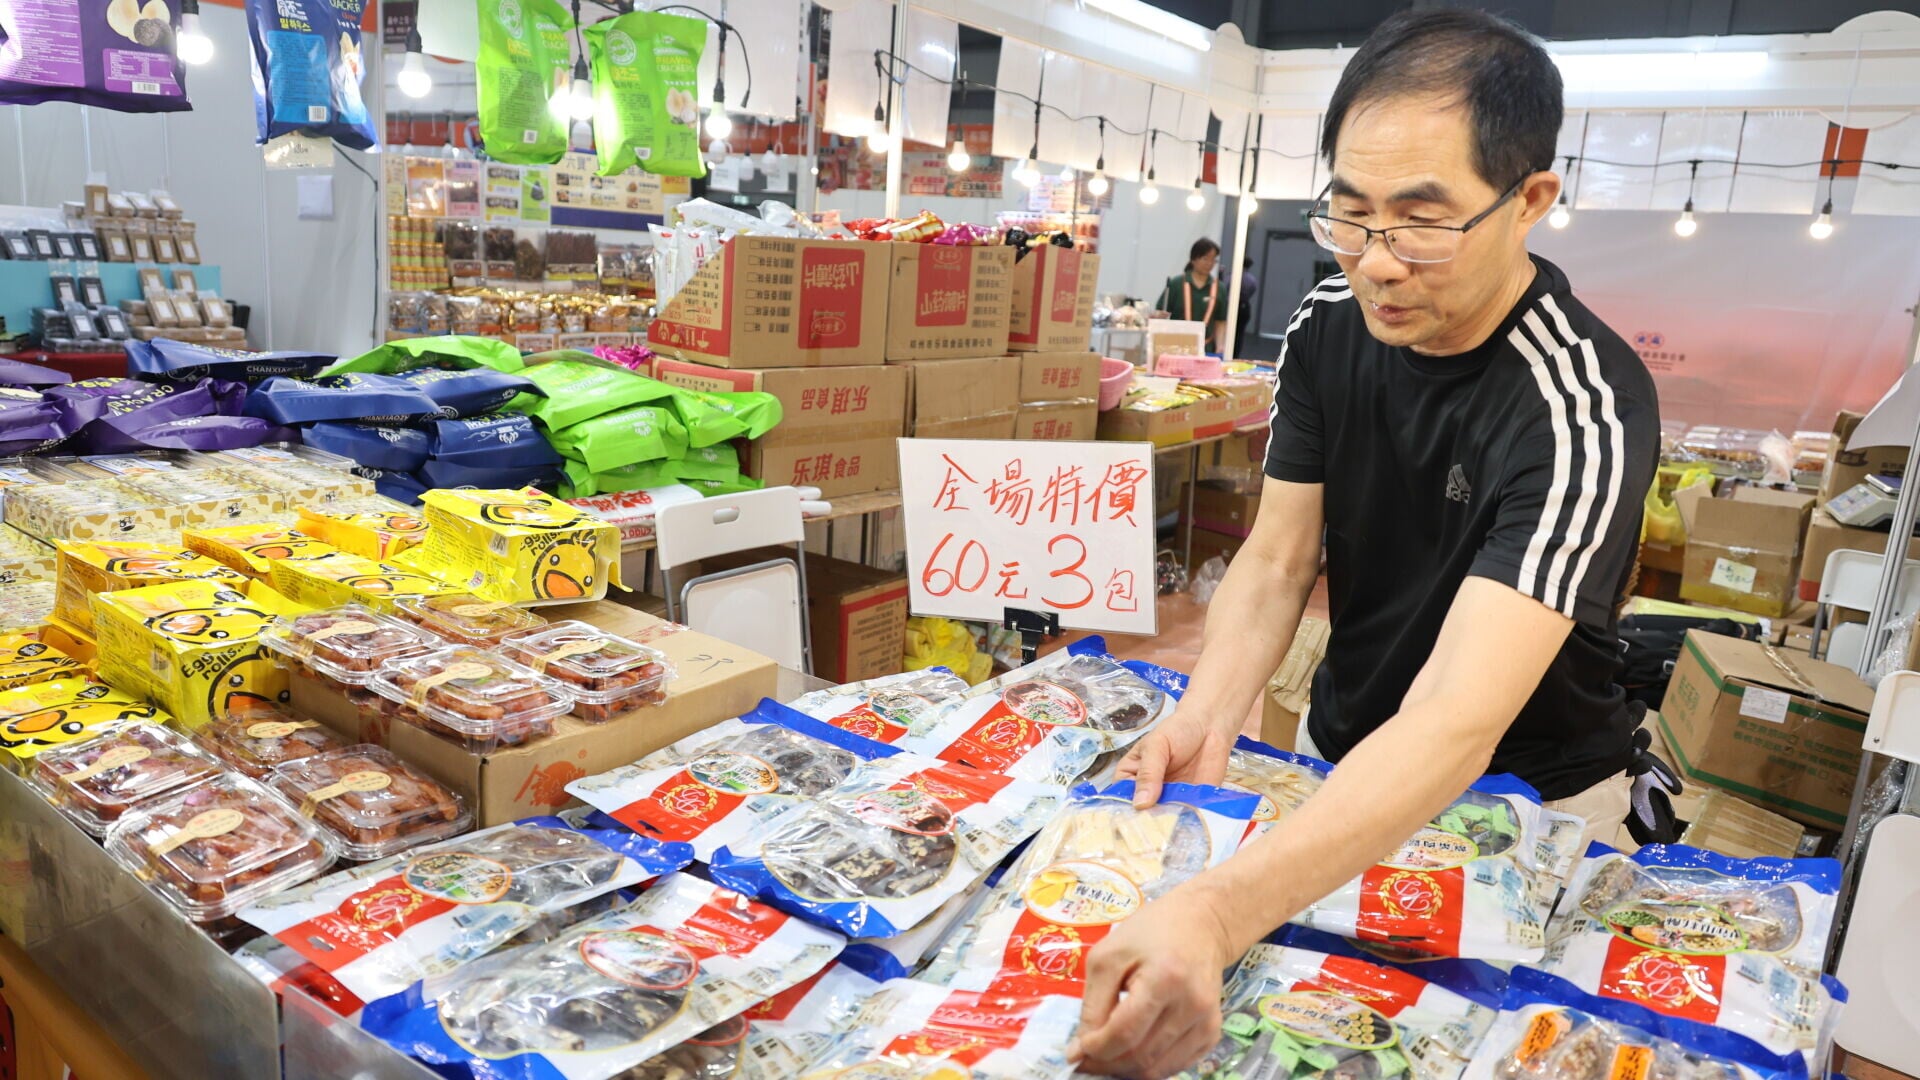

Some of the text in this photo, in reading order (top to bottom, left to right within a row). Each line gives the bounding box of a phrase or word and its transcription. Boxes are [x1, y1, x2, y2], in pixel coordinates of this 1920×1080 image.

[803, 261, 860, 291] 山药薄片
[919, 288, 968, 317] 山药薄片
[1041, 366, 1082, 388] 乐琪食品
[801, 385, 870, 415] 乐琪食品
[790, 453, 861, 486] 乐琪食品
[932, 453, 1148, 528] 全場特價
[181, 652, 215, 679] Egg
